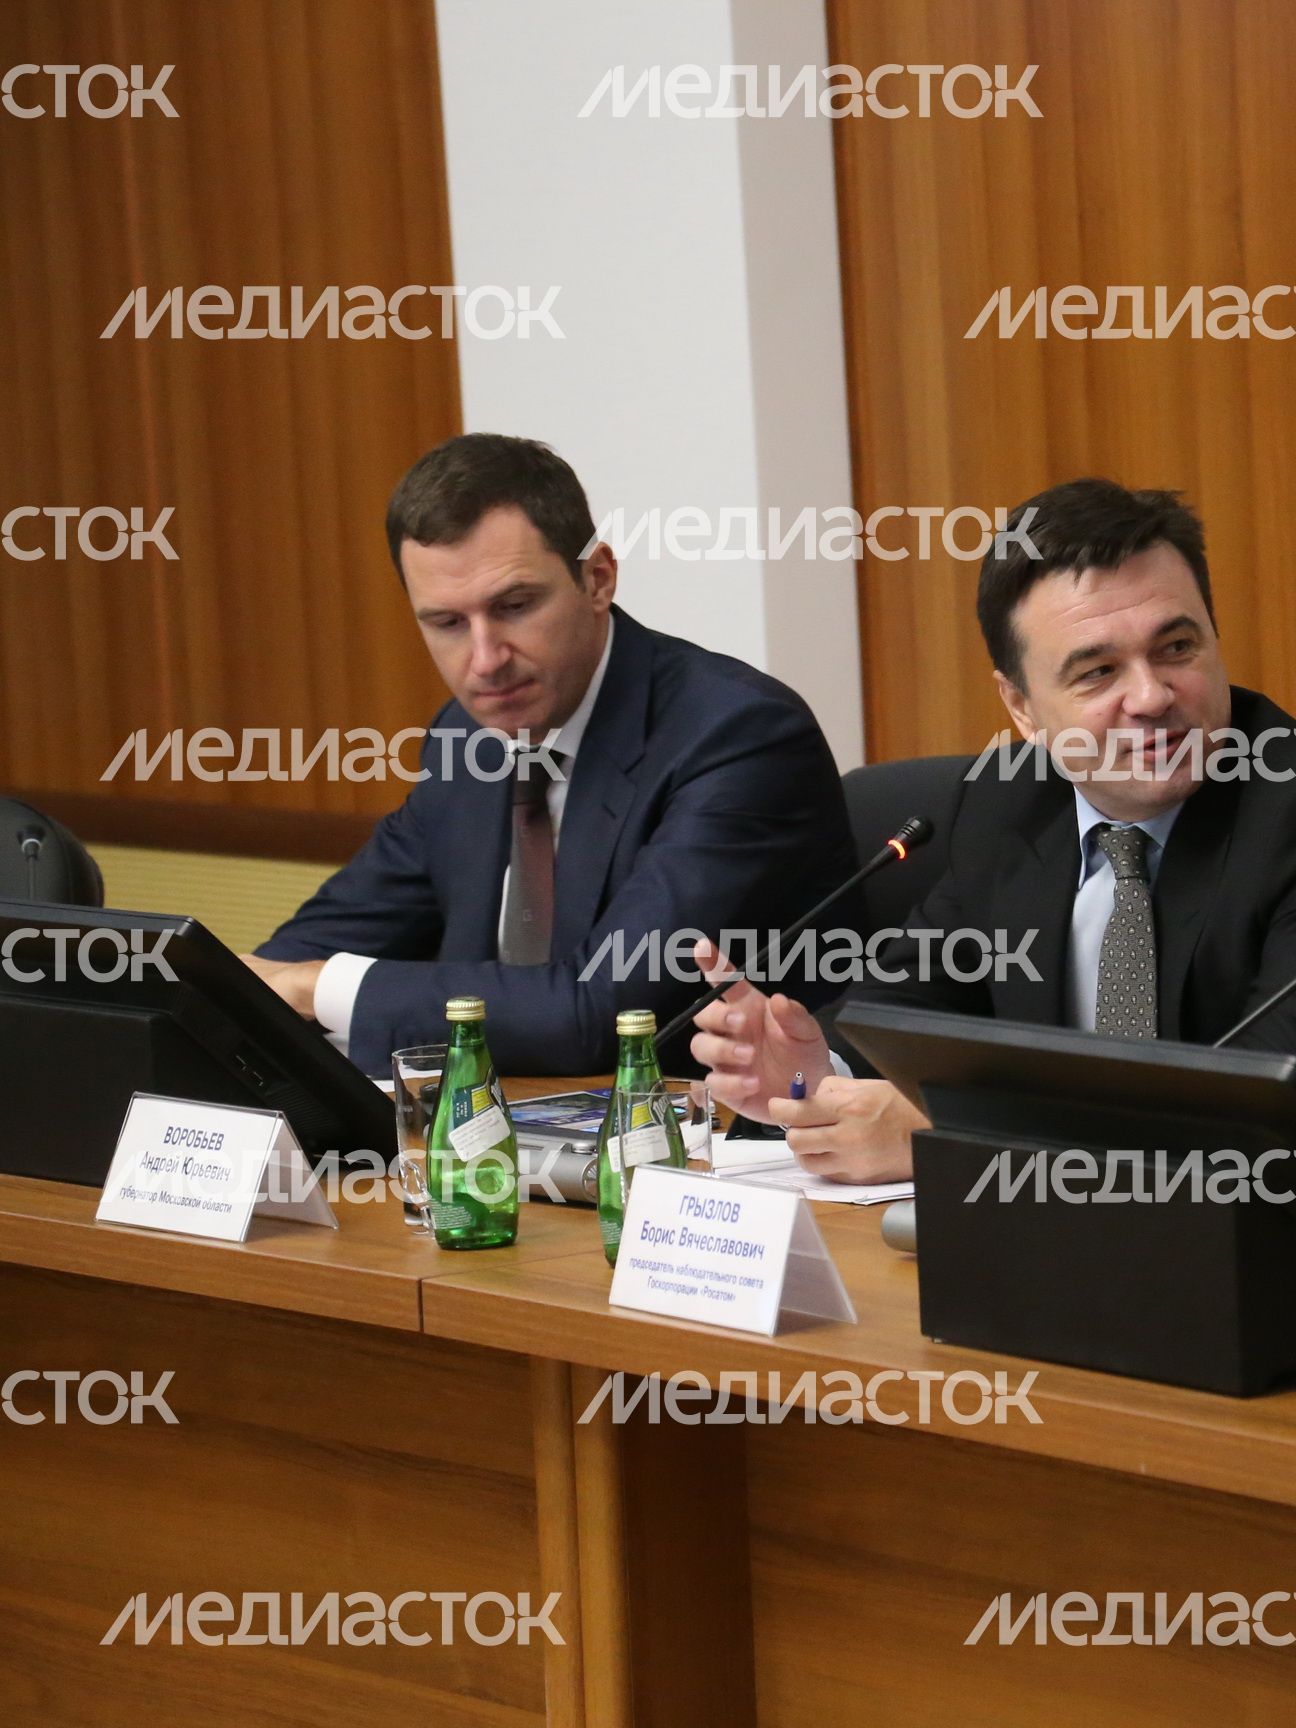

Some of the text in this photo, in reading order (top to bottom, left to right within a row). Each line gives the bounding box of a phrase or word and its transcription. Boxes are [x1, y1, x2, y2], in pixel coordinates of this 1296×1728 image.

[163, 1125, 225, 1151] ВОРОБЬЕВ
[139, 1151, 231, 1182] Андрей Юрьевич
[120, 1186, 233, 1214] губернатор Московской области
[678, 1195, 741, 1223] ГРЫЗЛОВ
[640, 1220, 676, 1247] Борис
[679, 1226, 765, 1260] Вячеславович
[629, 1257, 764, 1289] председатель наблюдательного совета
[647, 1275, 699, 1298] Госкорпорации
